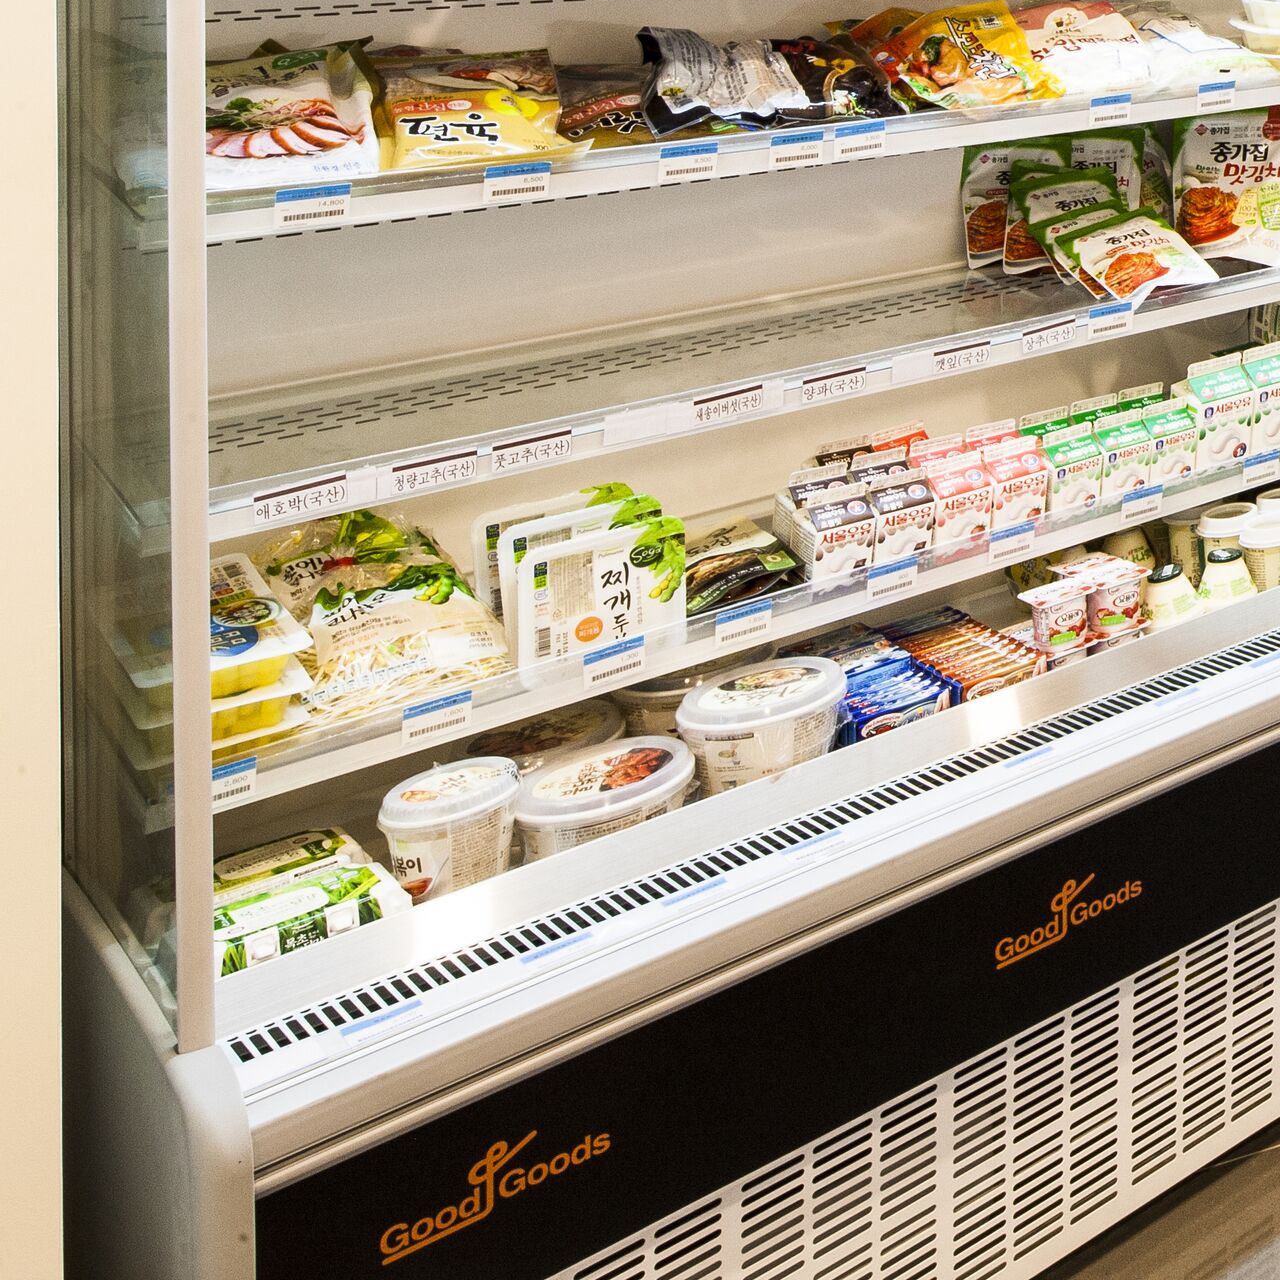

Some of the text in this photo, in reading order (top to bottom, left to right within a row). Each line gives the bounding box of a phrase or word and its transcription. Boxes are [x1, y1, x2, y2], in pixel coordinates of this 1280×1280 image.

[399, 111, 501, 146] 편육
[1209, 126, 1230, 135] 종가집
[1210, 141, 1269, 163] 종가집
[1104, 228, 1151, 245] 종가집
[1022, 325, 1076, 351] 상추(국산)
[803, 374, 866, 401] 양파(국산)
[694, 391, 763, 423] 새송이버섯(국산)
[1214, 396, 1251, 414] 서울우유
[1164, 429, 1196, 446] 서울우유
[493, 438, 572, 471] 풋고추(국산)
[1117, 442, 1150, 459] 서울우유
[1067, 458, 1101, 475] 서울우유
[1000, 473, 1046, 495] 서울우유
[255, 484, 347, 521] 애호박(국산)
[942, 489, 990, 512] 서울우유
[884, 505, 932, 528] 서울우유
[820, 522, 872, 545] 서울우유
[629, 545, 664, 567] Soga
[600, 561, 631, 639] 찌개두
[995, 879, 1143, 963] Good Goods
[380, 1132, 611, 1255] Good Goods
